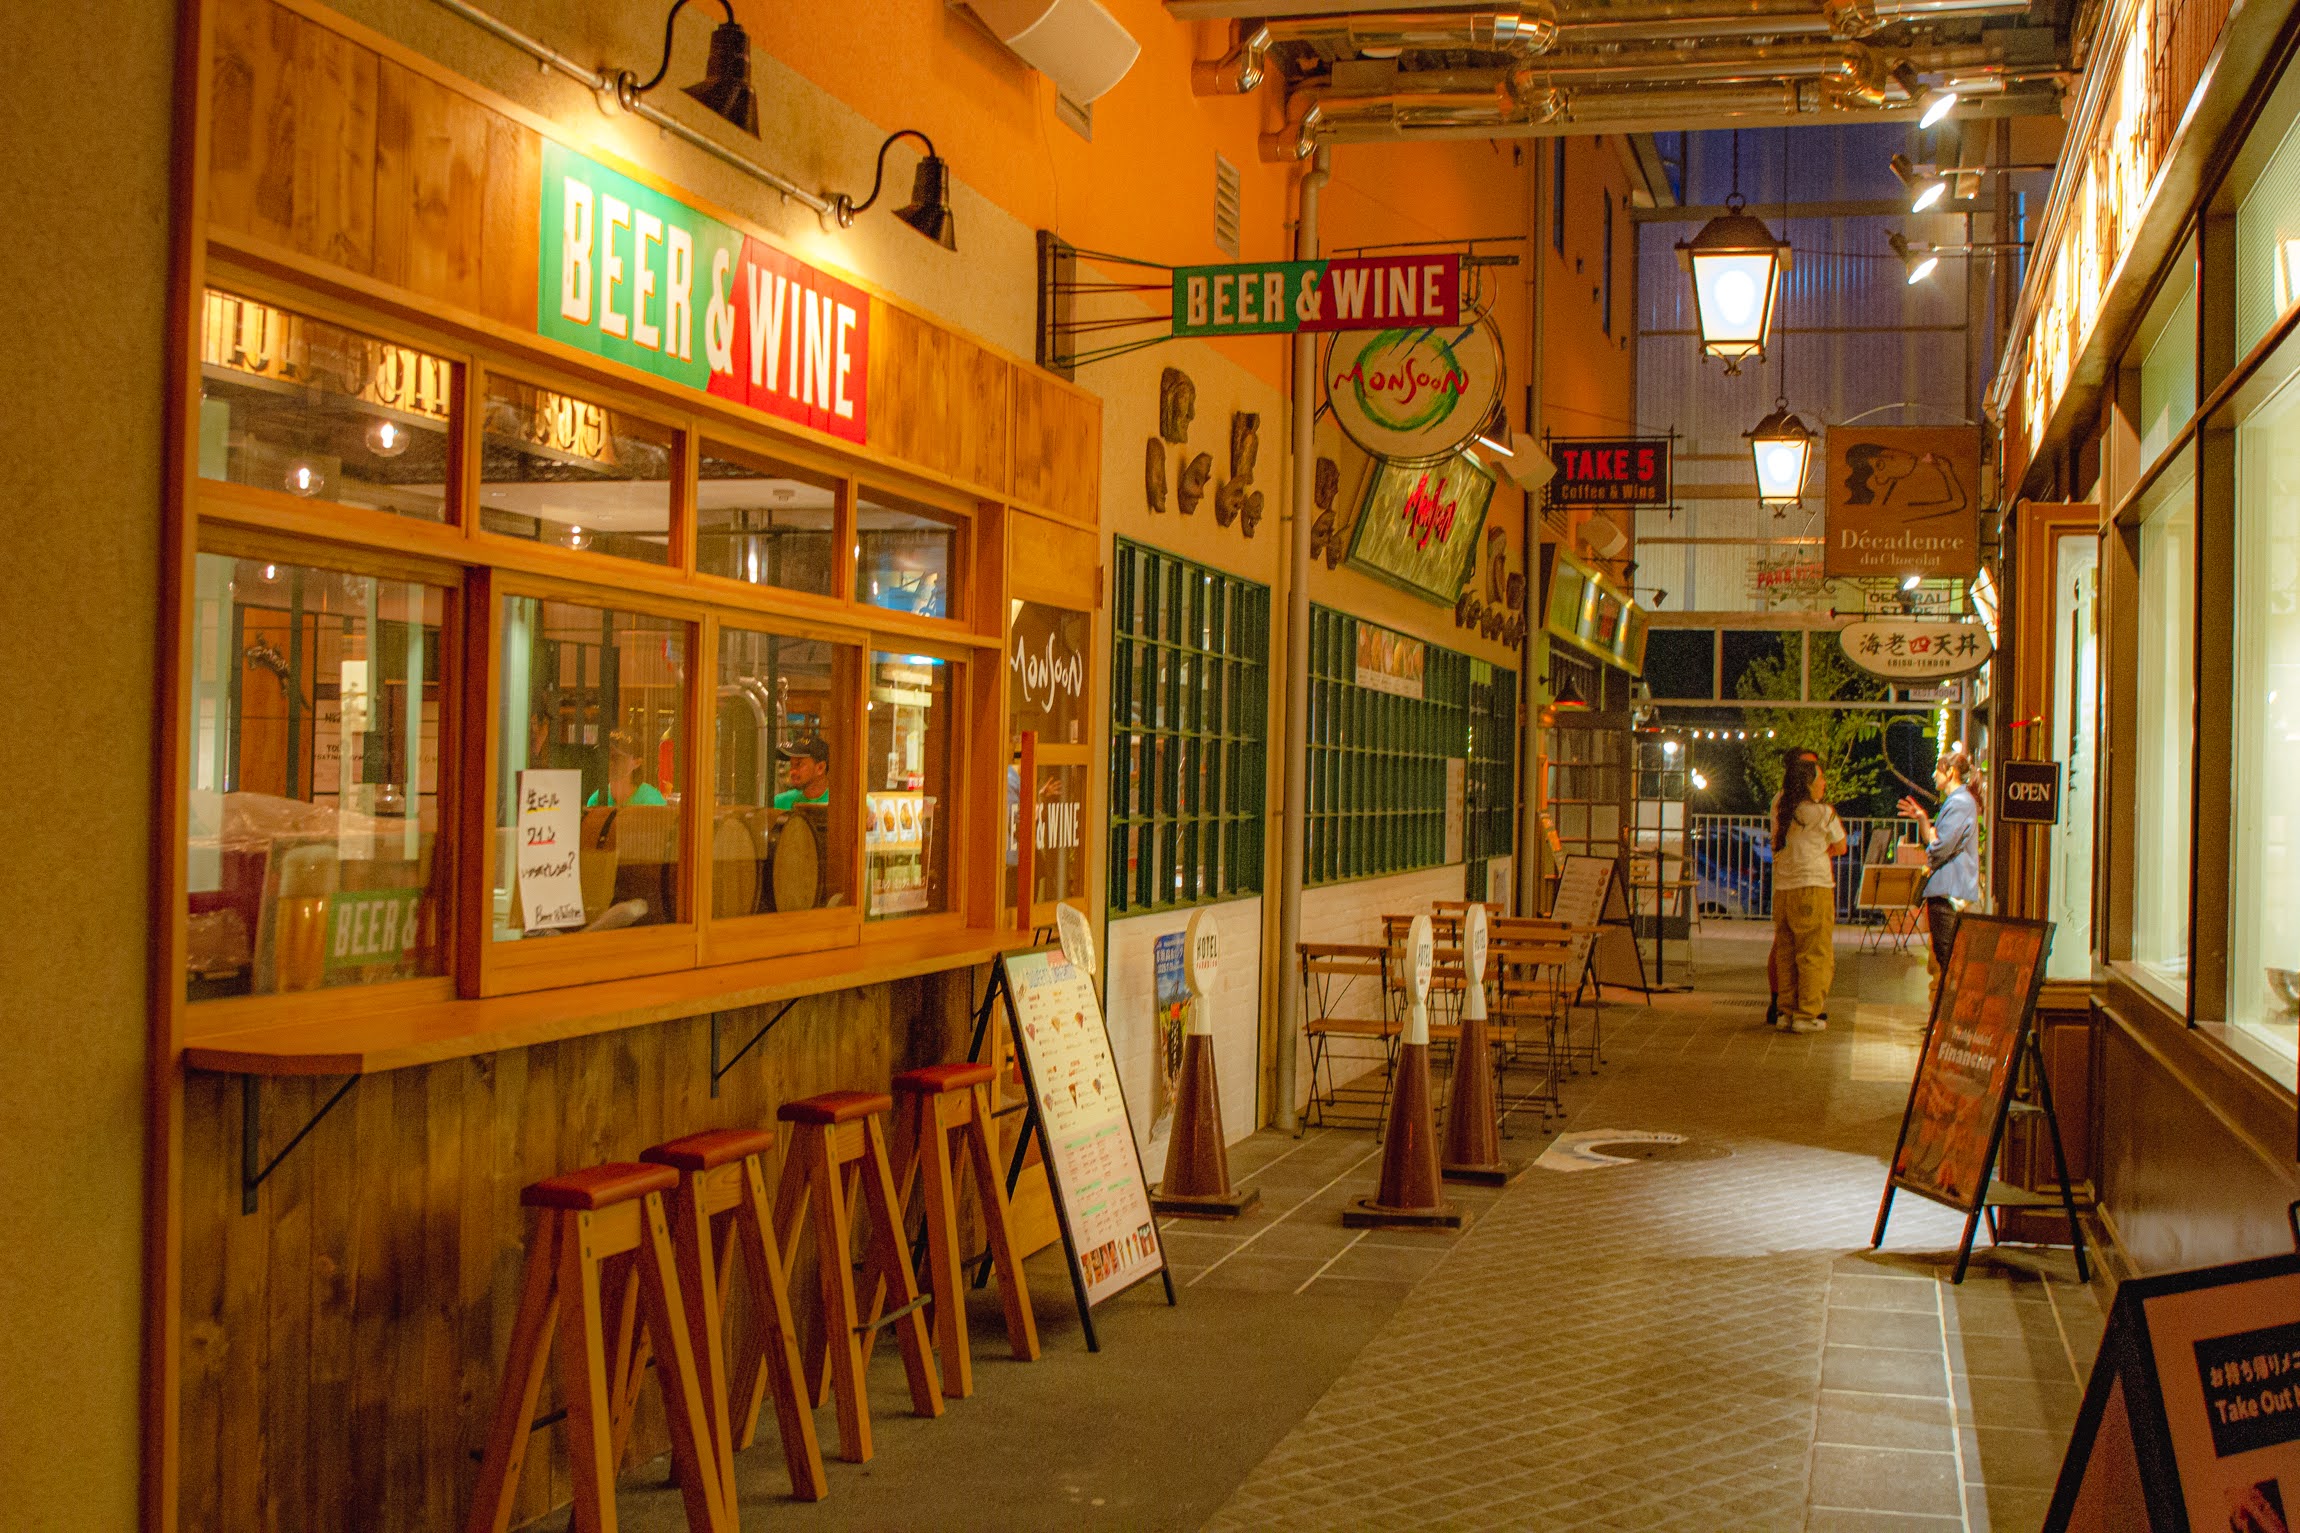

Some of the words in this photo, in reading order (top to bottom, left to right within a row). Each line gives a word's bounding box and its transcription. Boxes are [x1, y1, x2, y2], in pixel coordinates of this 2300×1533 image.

[560, 175, 695, 364] BEER
[704, 247, 735, 377] &
[747, 261, 857, 410] WINE
[1186, 271, 1285, 327] BEER
[1295, 269, 1322, 322] &
[1331, 264, 1445, 321] WINE
[1563, 449, 1629, 480] TAKE
[1637, 448, 1656, 481] 5
[1561, 483, 1606, 500] Coffee
[1609, 484, 1619, 499] &
[1621, 483, 1656, 500] Wine
[1840, 528, 1964, 550] Décadence
[1859, 632, 1980, 658] 海老四天丼
[2008, 781, 2052, 802] OPEN
[1047, 802, 1081, 850] WINE
[333, 899, 400, 957] BEER
[1196, 935, 1218, 961] HOTEL
[1937, 1041, 1997, 1072] Financier
[2215, 1395, 2259, 1424] Take
[2260, 1389, 2293, 1415] Out
